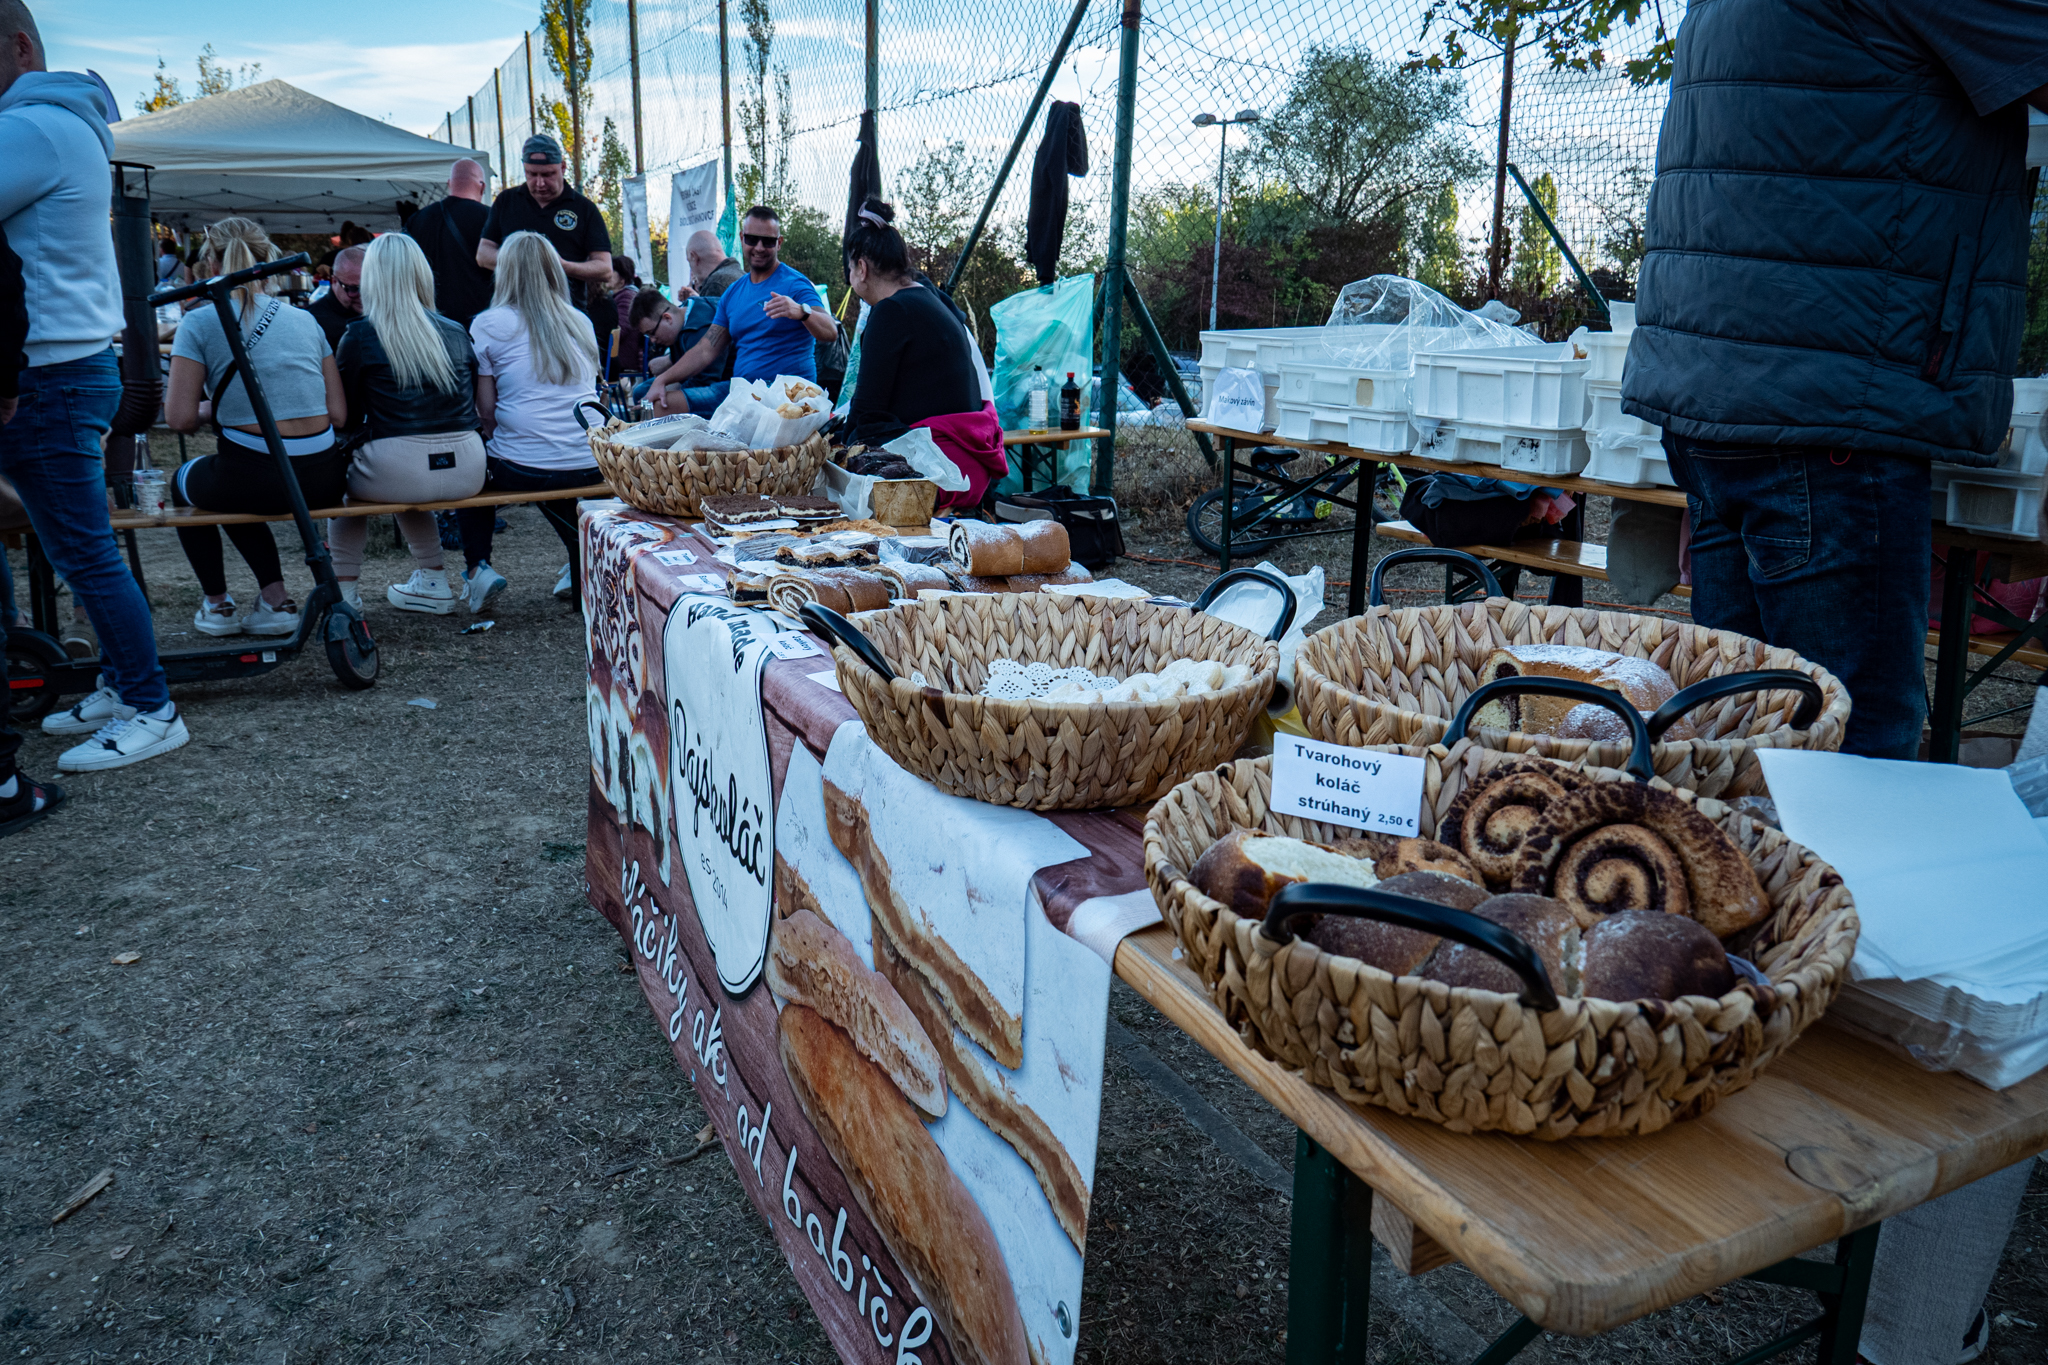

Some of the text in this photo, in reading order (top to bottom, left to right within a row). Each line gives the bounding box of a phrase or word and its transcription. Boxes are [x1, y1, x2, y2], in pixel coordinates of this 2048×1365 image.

[1218, 396, 1255, 406] Makový závin
[687, 602, 749, 629] Hand
[727, 619, 757, 674] made
[1294, 744, 1382, 776] Tvarohový
[1315, 772, 1361, 794] koláč
[1298, 796, 1414, 828] strúhaný 2,50 €
[712, 869, 728, 911] 2014
[737, 1101, 771, 1187] od
